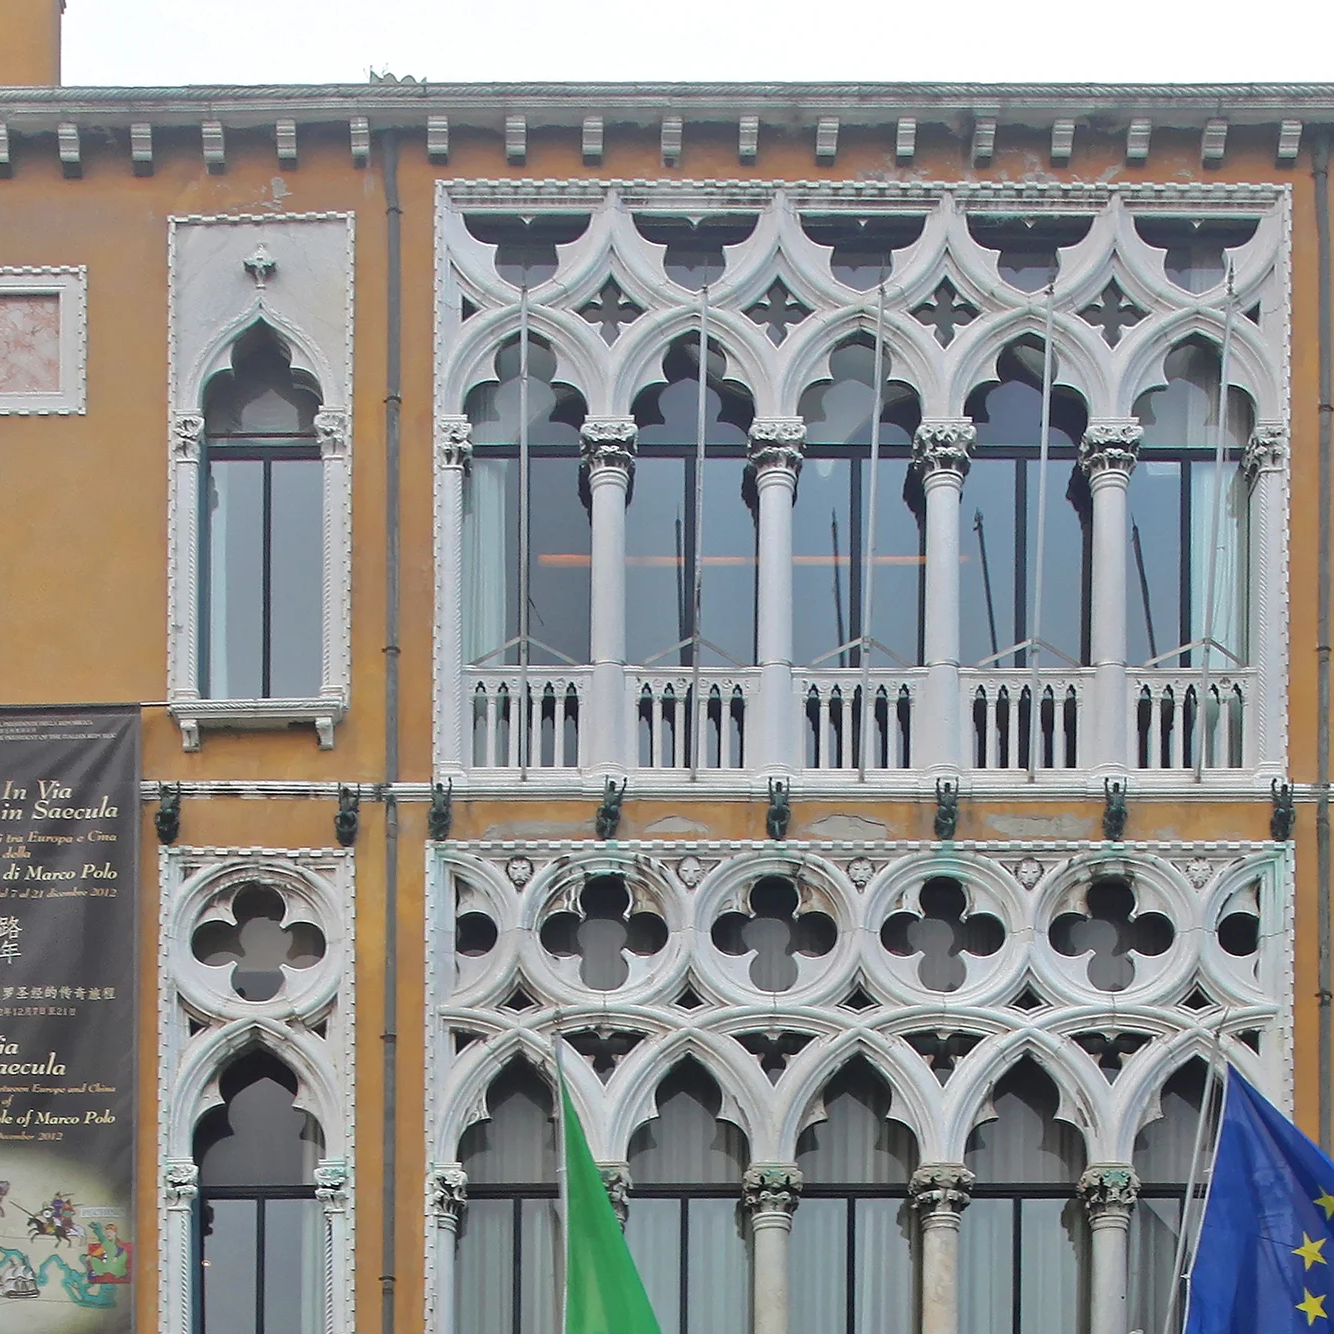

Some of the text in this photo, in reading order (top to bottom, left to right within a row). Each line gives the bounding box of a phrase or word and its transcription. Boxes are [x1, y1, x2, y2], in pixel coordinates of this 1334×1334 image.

[1, 779, 73, 800] In Via
[1, 796, 119, 820] in Saecula
[27, 831, 74, 846] Europa
[3, 863, 21, 881] di
[24, 865, 76, 881] Marco
[81, 862, 118, 880] Polo
[90, 887, 118, 898] 2012
[17, 1109, 34, 1127] of
[35, 1111, 80, 1125] Marco
[83, 1109, 116, 1125] Polo
[37, 1131, 64, 1141] 2012
